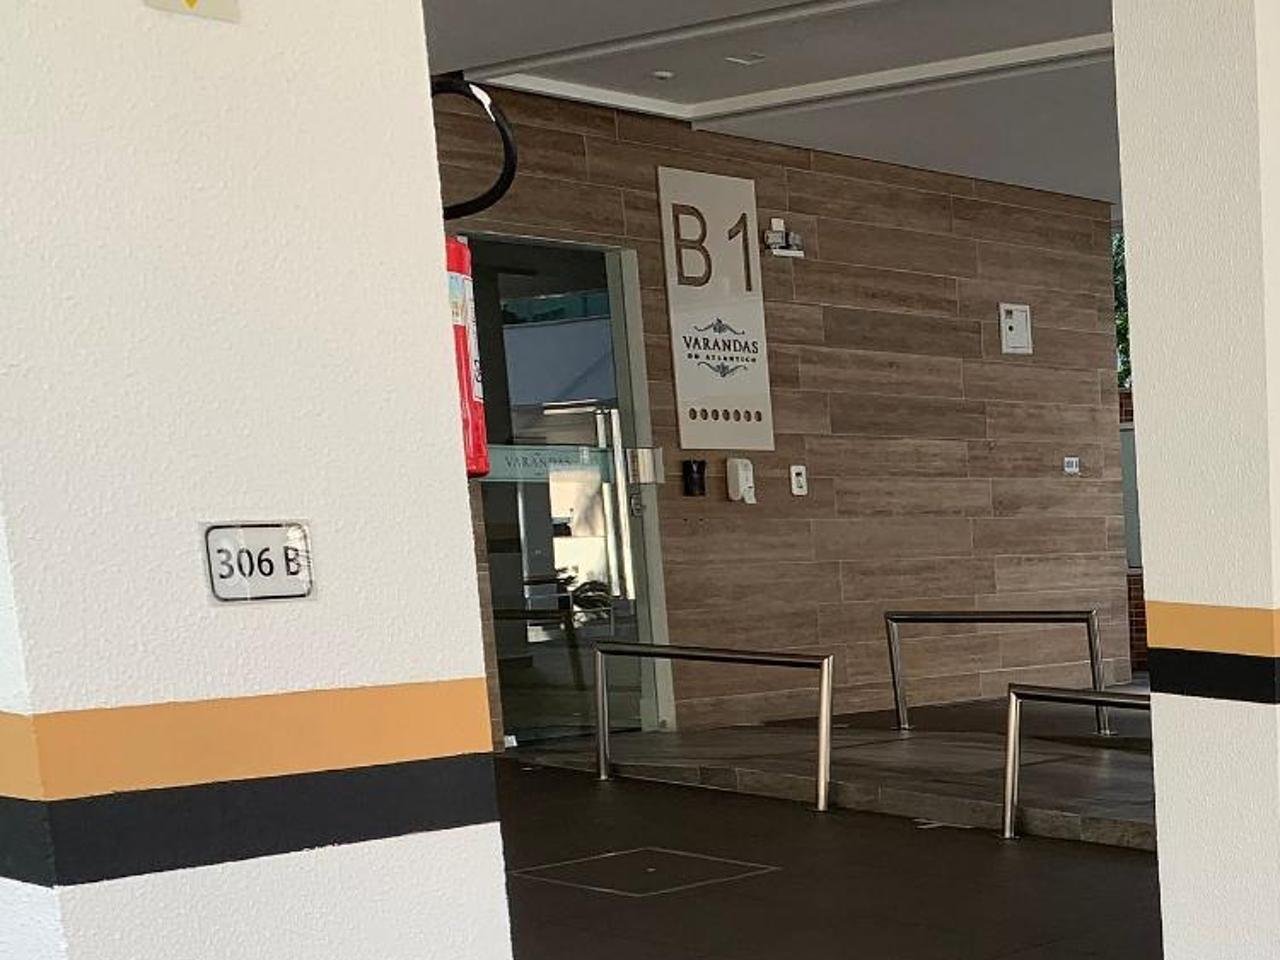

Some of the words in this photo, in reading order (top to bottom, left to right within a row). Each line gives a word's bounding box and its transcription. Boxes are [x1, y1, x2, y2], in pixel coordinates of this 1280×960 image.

[682, 335, 759, 354] VARANDAS
[217, 547, 274, 579] 306
[283, 546, 301, 576] B
